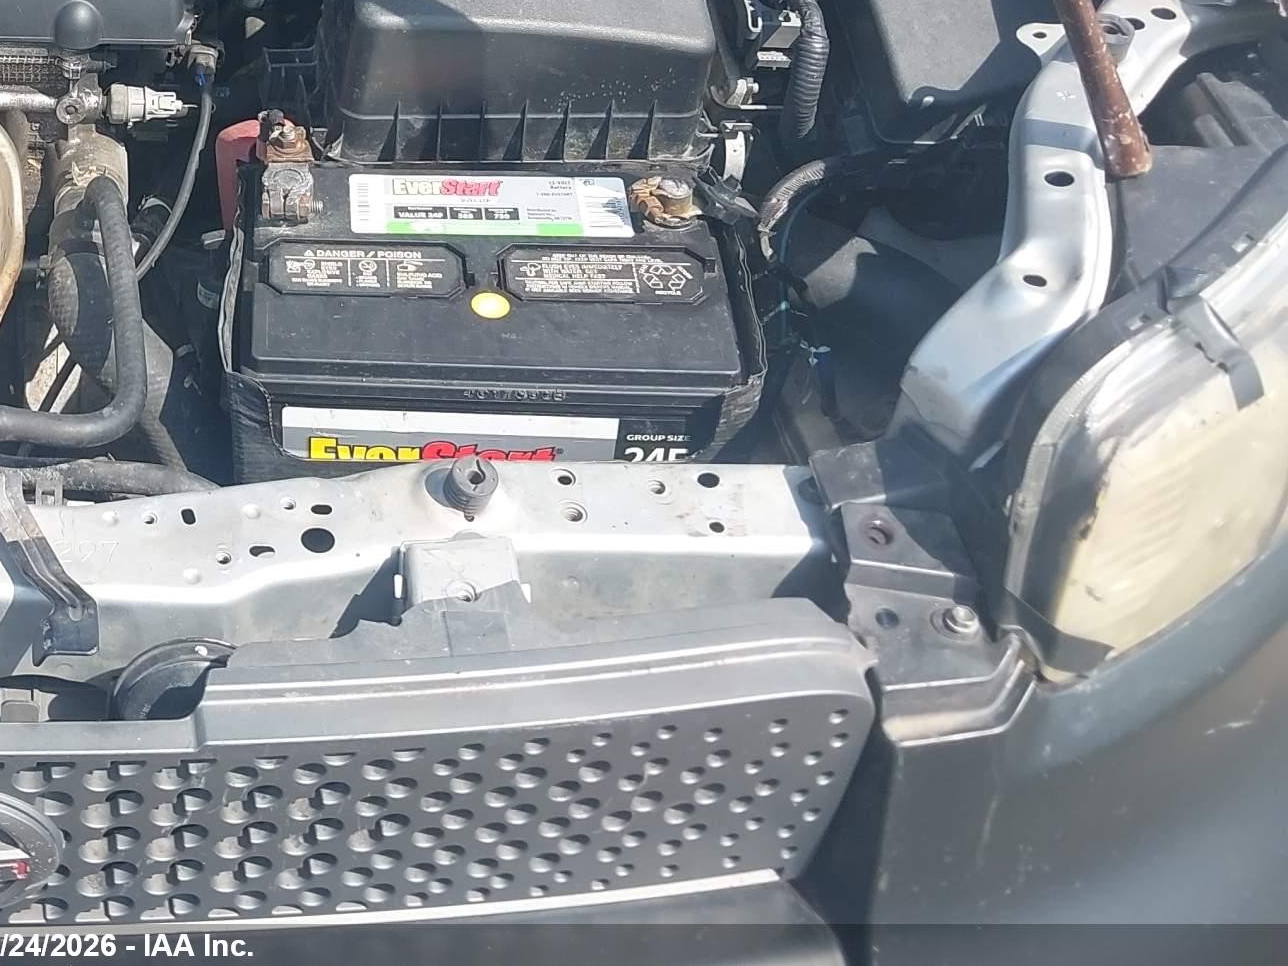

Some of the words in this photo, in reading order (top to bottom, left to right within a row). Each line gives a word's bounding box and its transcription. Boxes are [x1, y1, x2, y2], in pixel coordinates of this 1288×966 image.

[392, 177, 500, 197] EverStart
[316, 249, 365, 258] DANGER
[377, 251, 422, 259] POISON
[626, 434, 665, 442] GROUP
[666, 434, 692, 442] SIZE
